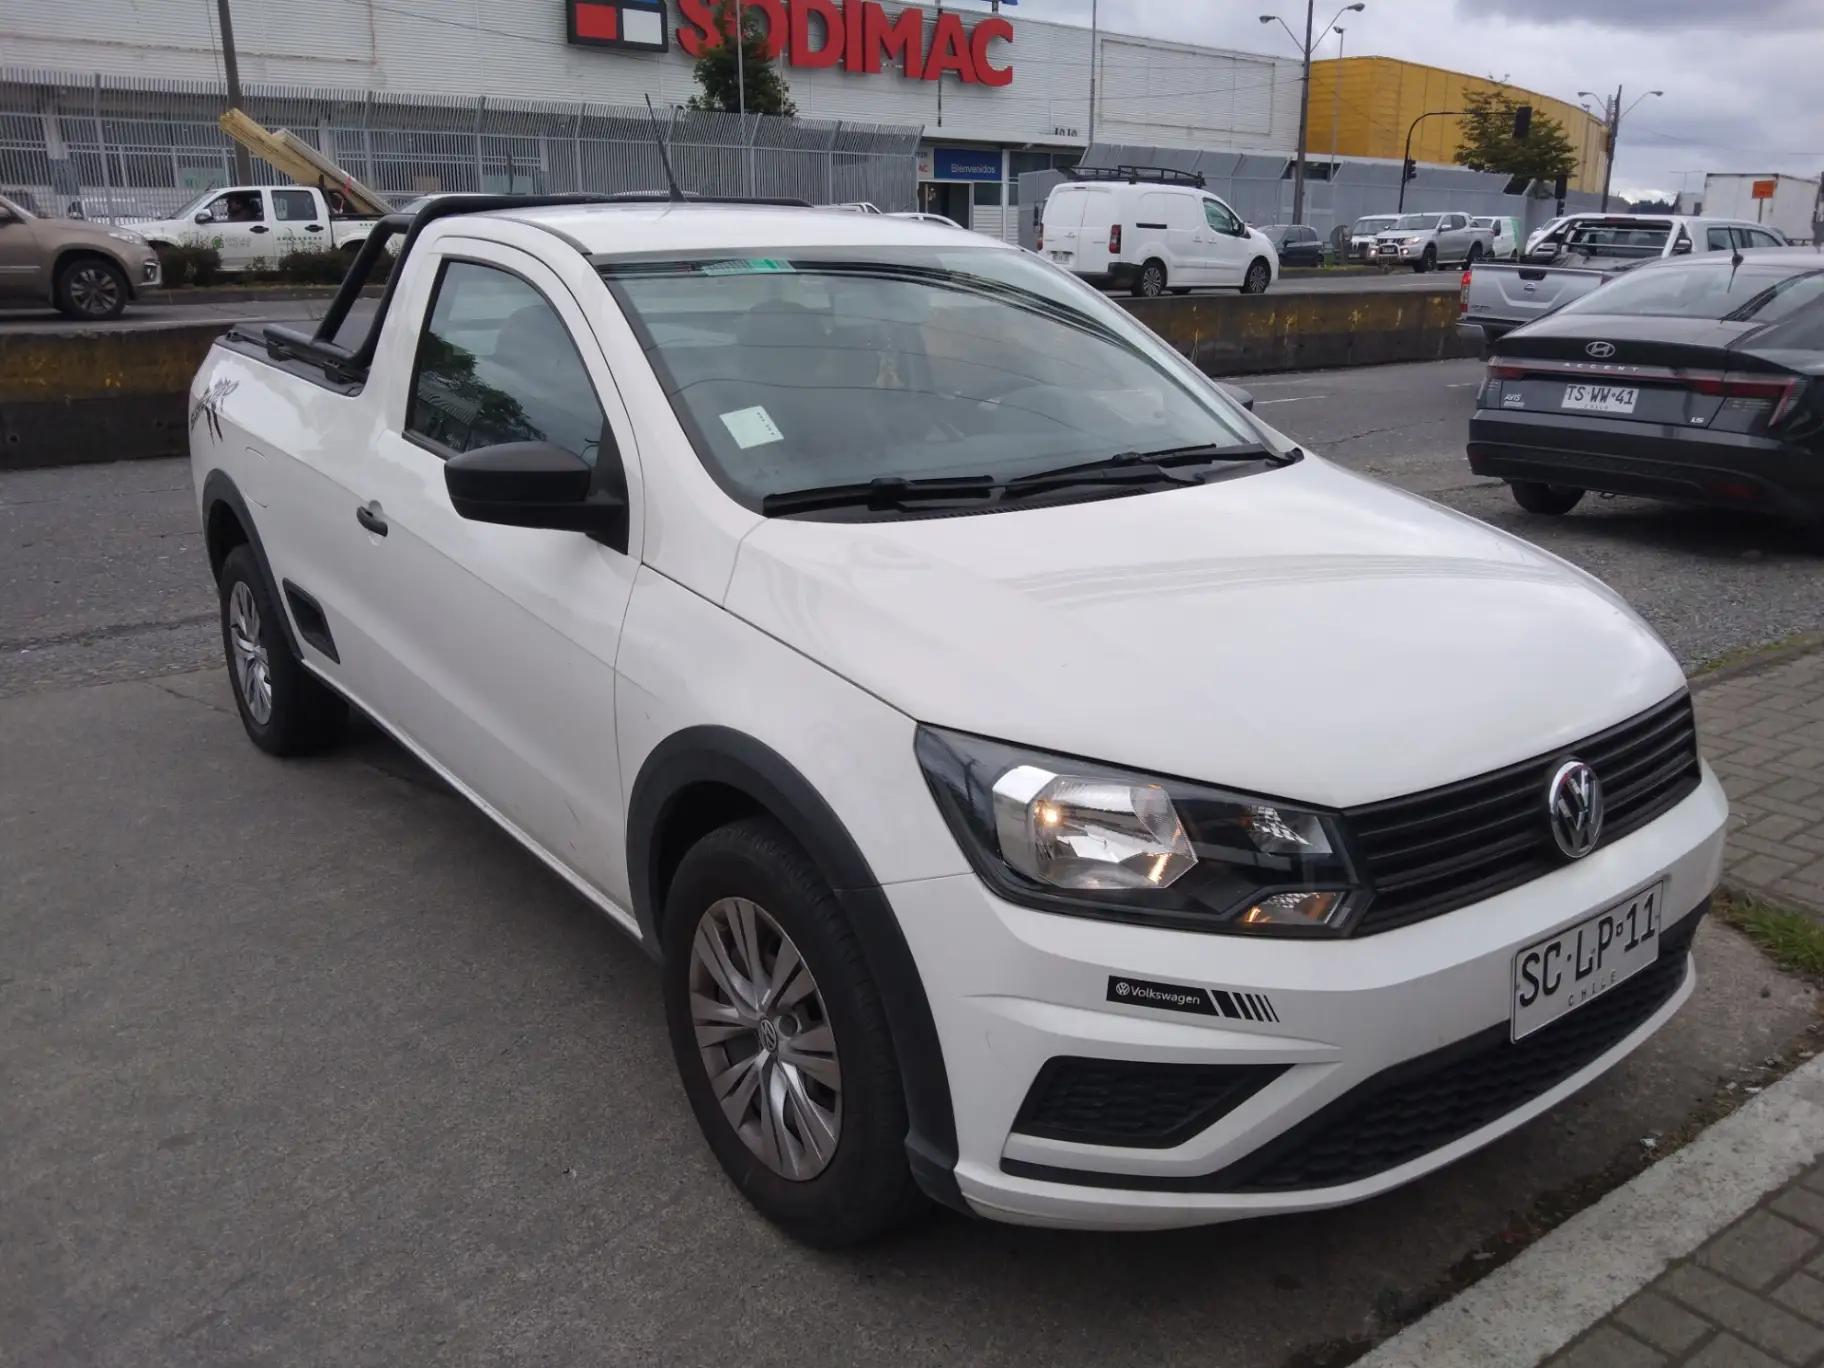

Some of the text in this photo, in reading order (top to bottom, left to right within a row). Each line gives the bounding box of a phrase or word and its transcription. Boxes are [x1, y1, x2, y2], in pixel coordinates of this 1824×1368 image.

[675, 0, 1013, 87] SODIMAC
[951, 163, 996, 174] Bienvenidos
[1563, 362, 1640, 371] ACCENT
[1131, 986, 1201, 1006] Volkswagen
